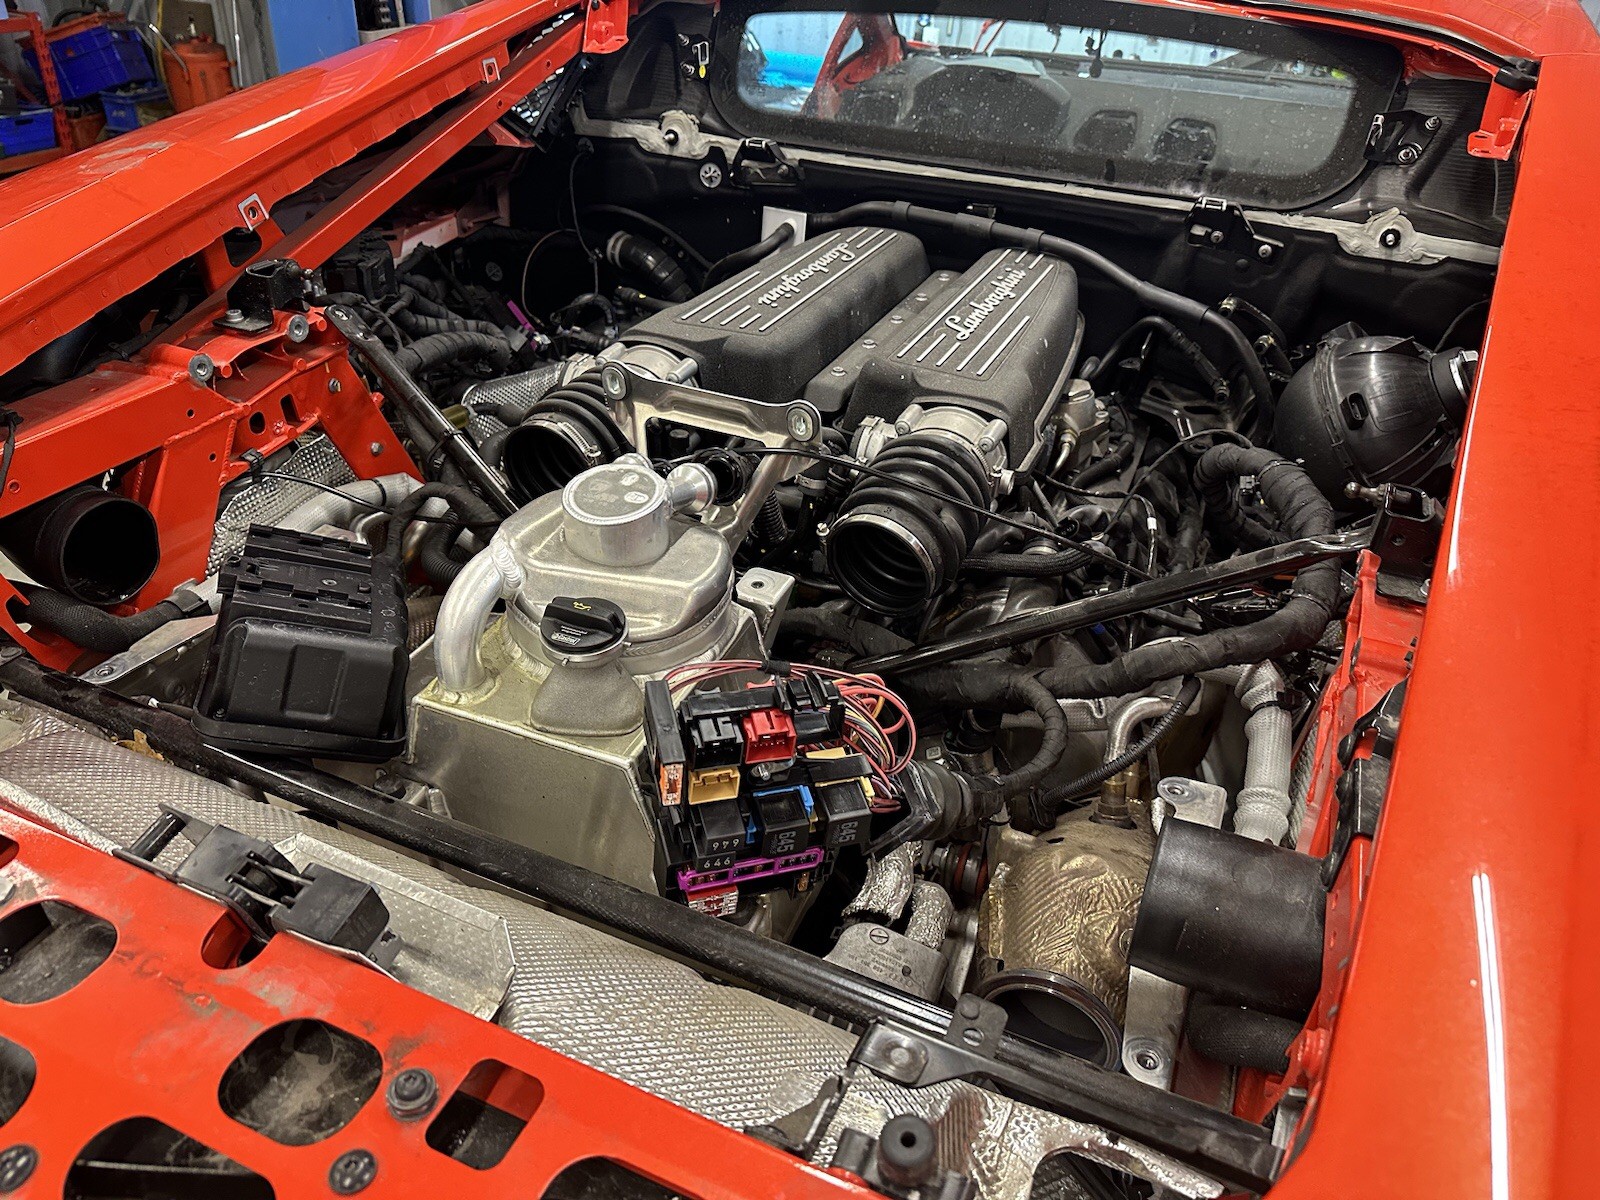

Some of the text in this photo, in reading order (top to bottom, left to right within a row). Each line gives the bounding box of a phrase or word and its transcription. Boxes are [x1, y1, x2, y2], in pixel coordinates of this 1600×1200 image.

[758, 243, 856, 308] Lamborghini
[945, 267, 1026, 341] Lamborghini
[777, 830, 797, 853] 645
[838, 821, 859, 843] 645
[703, 856, 731, 869] 646
